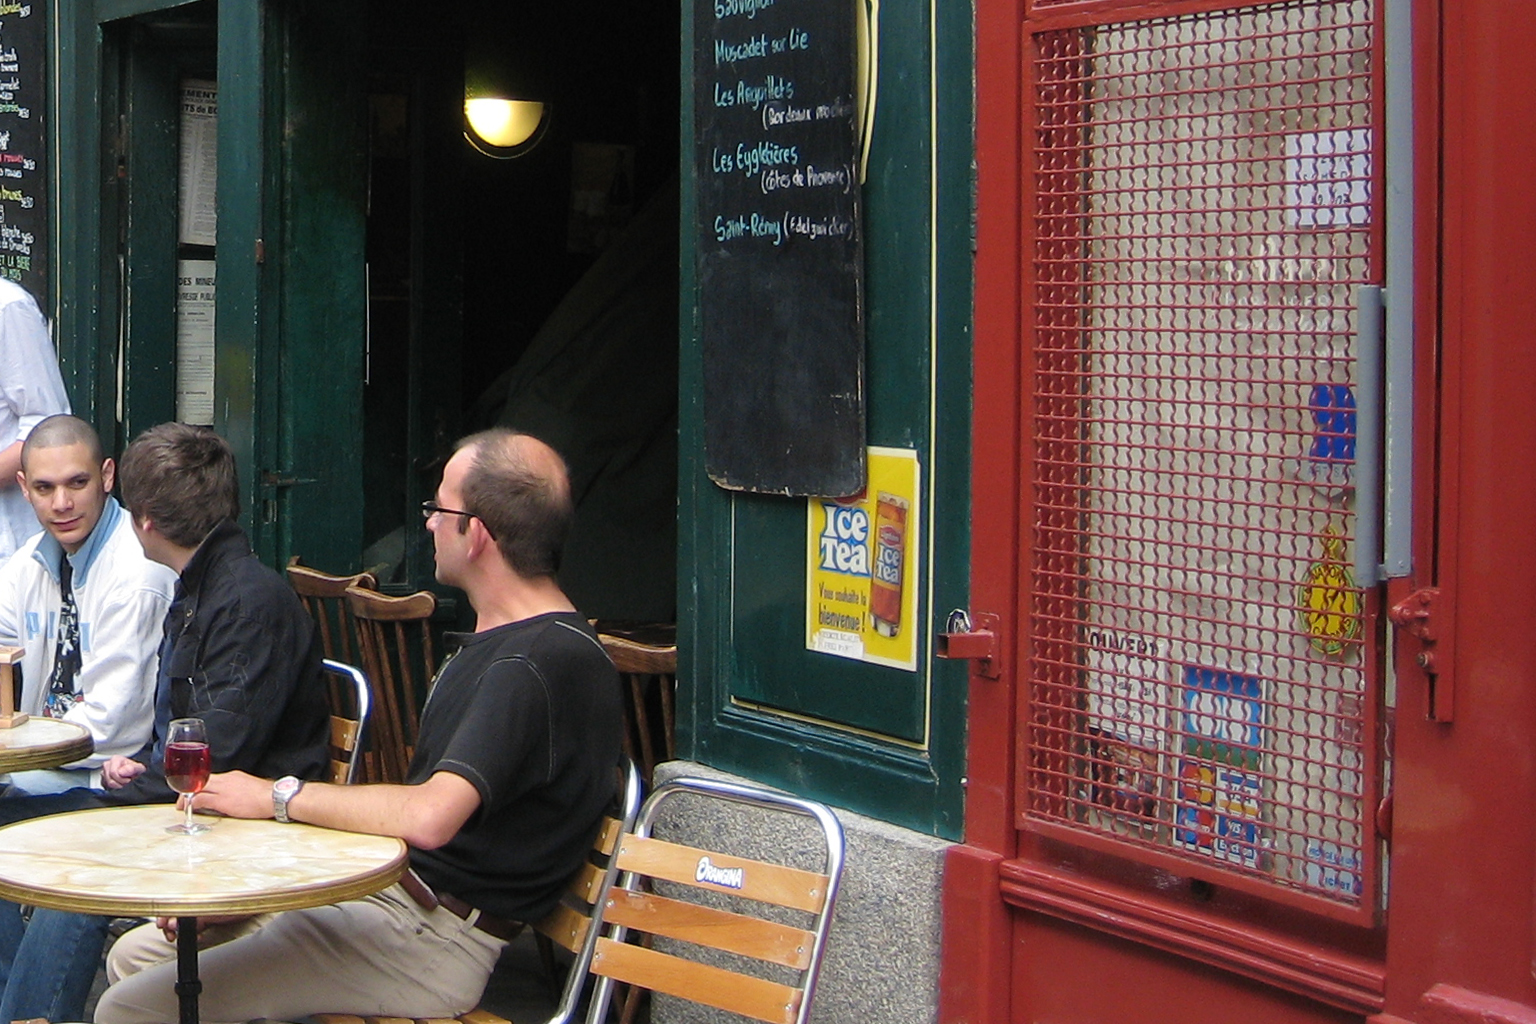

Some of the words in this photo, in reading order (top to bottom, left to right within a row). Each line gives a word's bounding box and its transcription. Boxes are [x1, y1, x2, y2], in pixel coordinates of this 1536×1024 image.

[714, 33, 768, 65] Muscadet
[771, 37, 787, 54] sur
[789, 27, 809, 50] Lie
[715, 82, 735, 107] Les
[713, 147, 733, 173] Les
[792, 167, 804, 187] de
[823, 504, 869, 542] Ice
[820, 536, 870, 576] Tea
[877, 543, 900, 567] Ice
[876, 560, 900, 583] Tea
